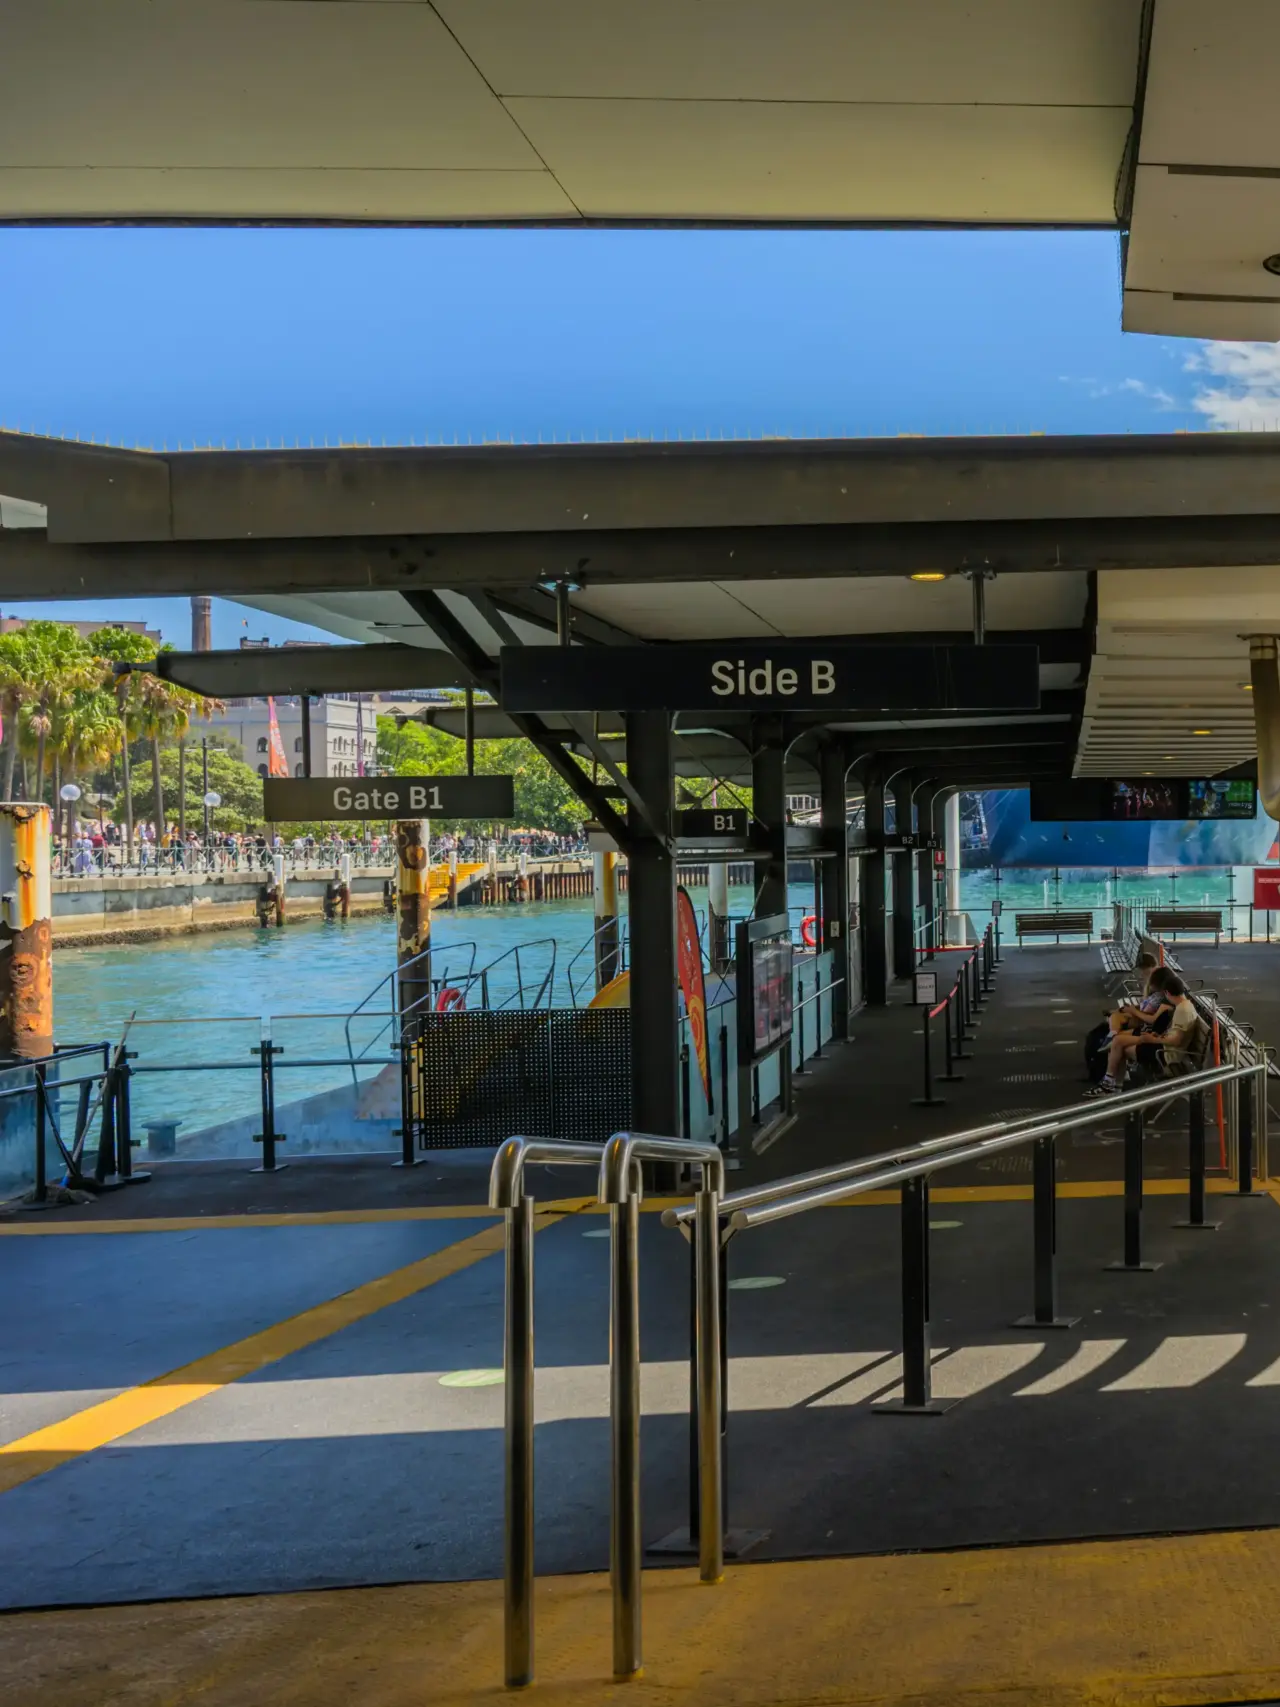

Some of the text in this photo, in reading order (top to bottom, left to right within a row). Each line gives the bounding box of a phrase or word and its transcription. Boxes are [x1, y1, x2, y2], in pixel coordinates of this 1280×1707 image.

[711, 659, 836, 696] Side B
[333, 786, 444, 812] Gate B1
[714, 814, 737, 832] B1
[901, 836, 914, 845] B2
[927, 840, 937, 848] B3
